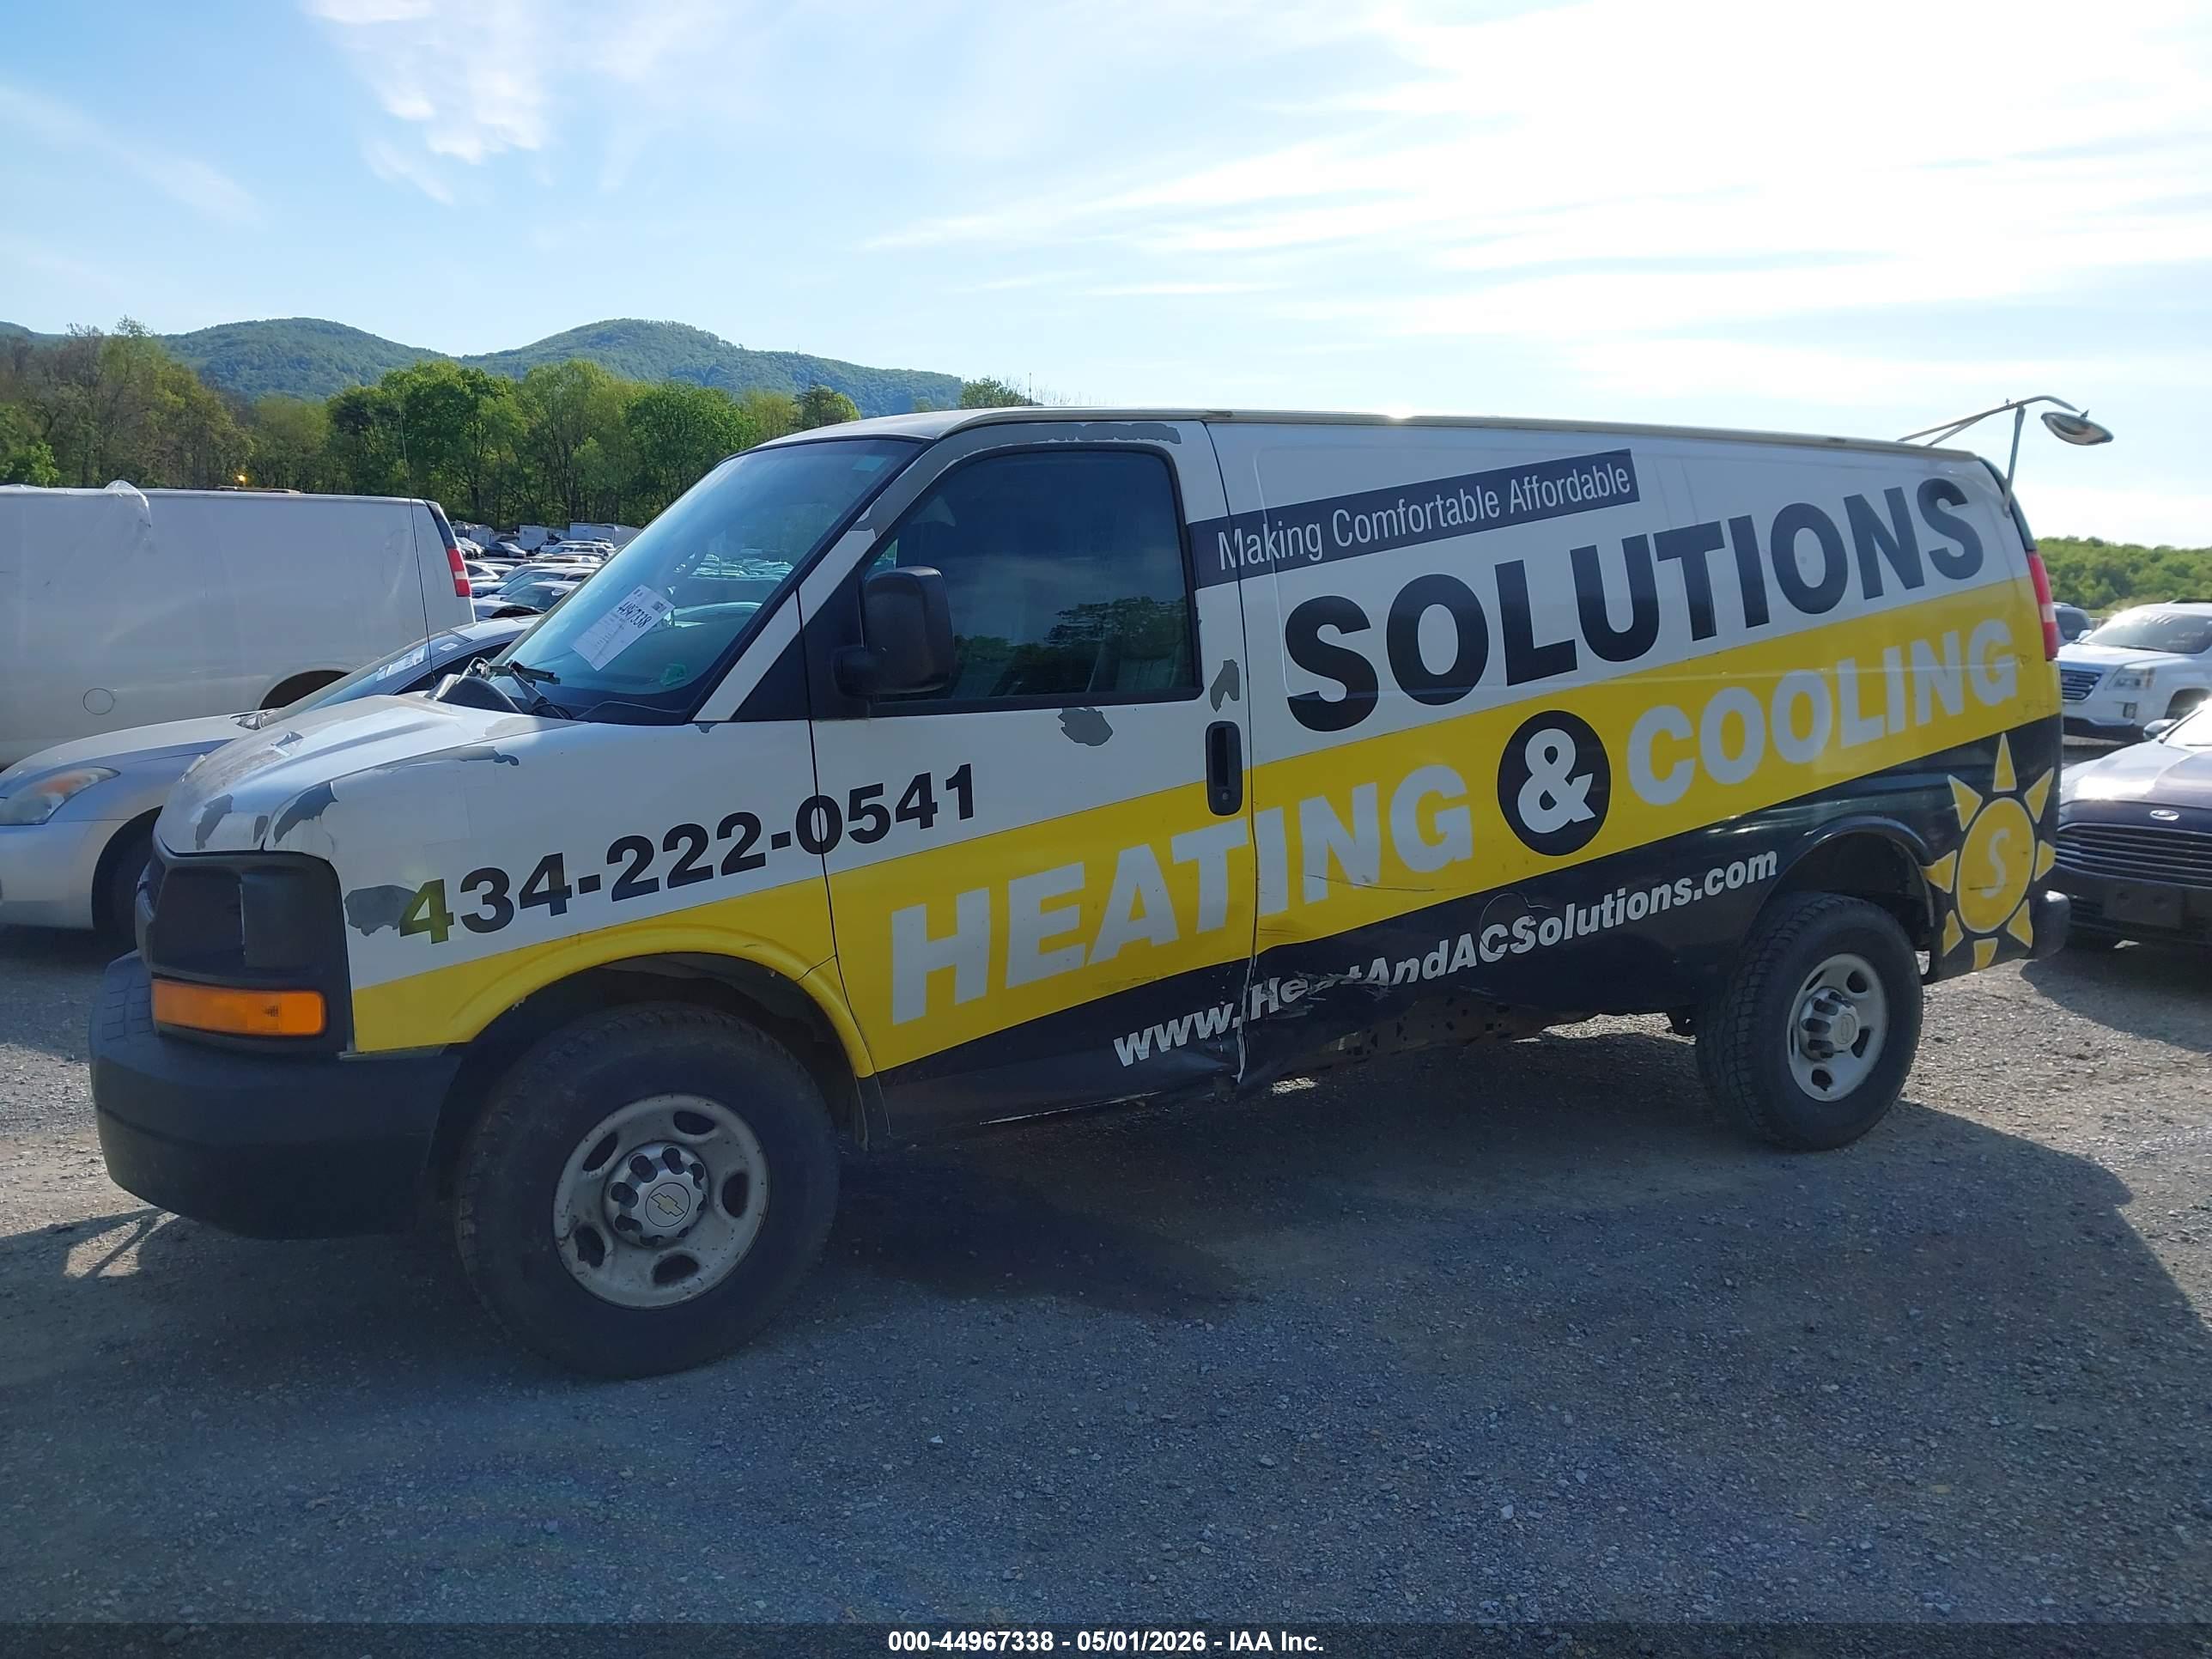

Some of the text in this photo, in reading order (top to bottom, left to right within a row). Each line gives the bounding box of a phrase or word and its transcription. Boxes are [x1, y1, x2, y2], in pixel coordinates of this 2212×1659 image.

[1218, 463, 1632, 570] Making Comfortable Affordable
[1285, 478, 1984, 732] SOLUTIONS
[399, 763, 974, 945] 434-222-0541
[891, 618, 2018, 1026] HEATING & COOLING
[1980, 827, 2010, 898] S
